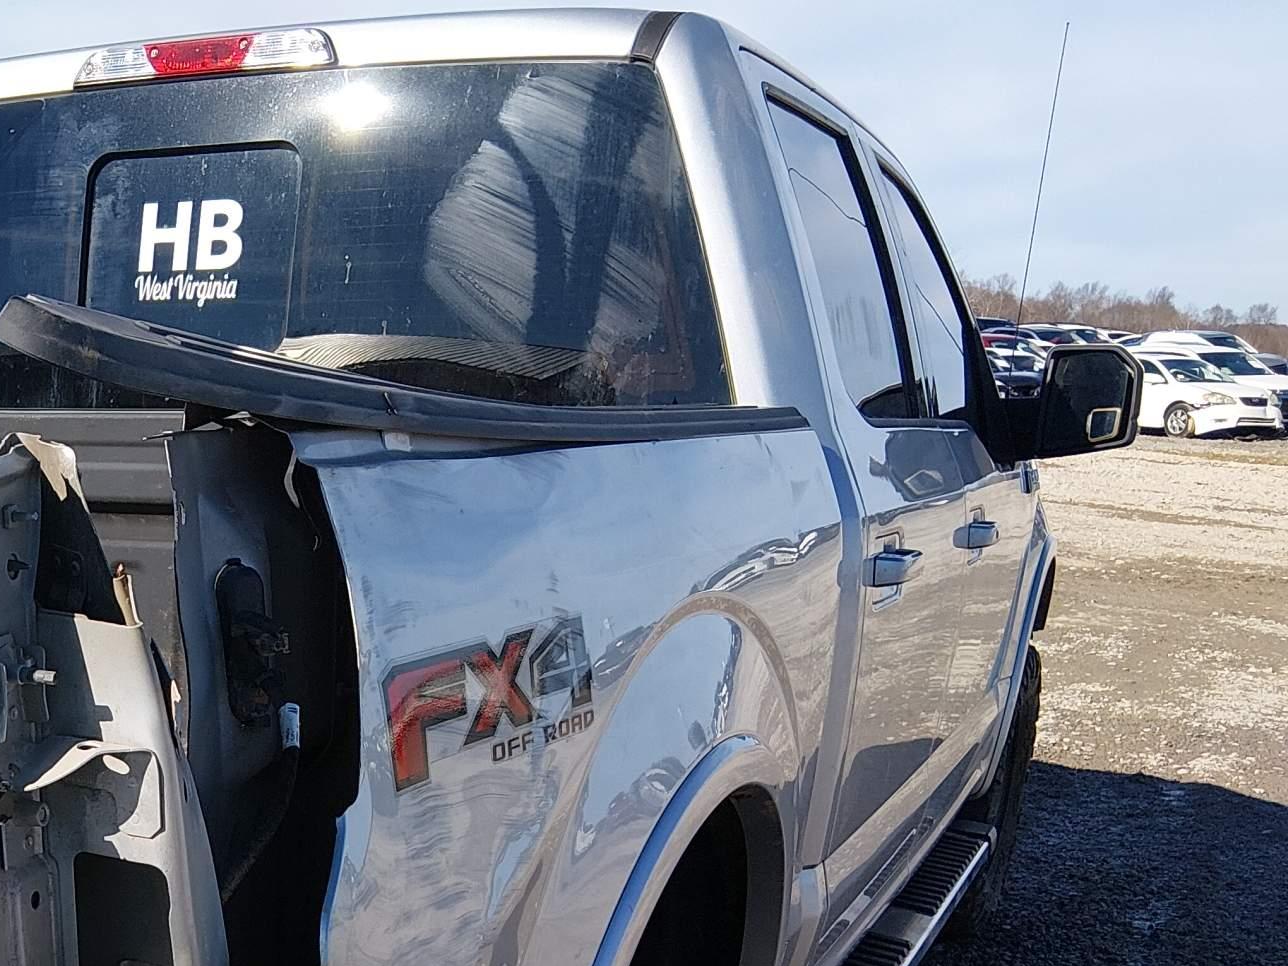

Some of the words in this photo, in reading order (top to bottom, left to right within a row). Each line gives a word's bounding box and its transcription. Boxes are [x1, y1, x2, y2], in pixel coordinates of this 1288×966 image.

[138, 199, 244, 272] HB
[134, 274, 173, 301] West
[174, 273, 238, 308] Virginia
[381, 616, 592, 792] FX4
[492, 730, 534, 762] OFF
[544, 709, 595, 743] ROAD
